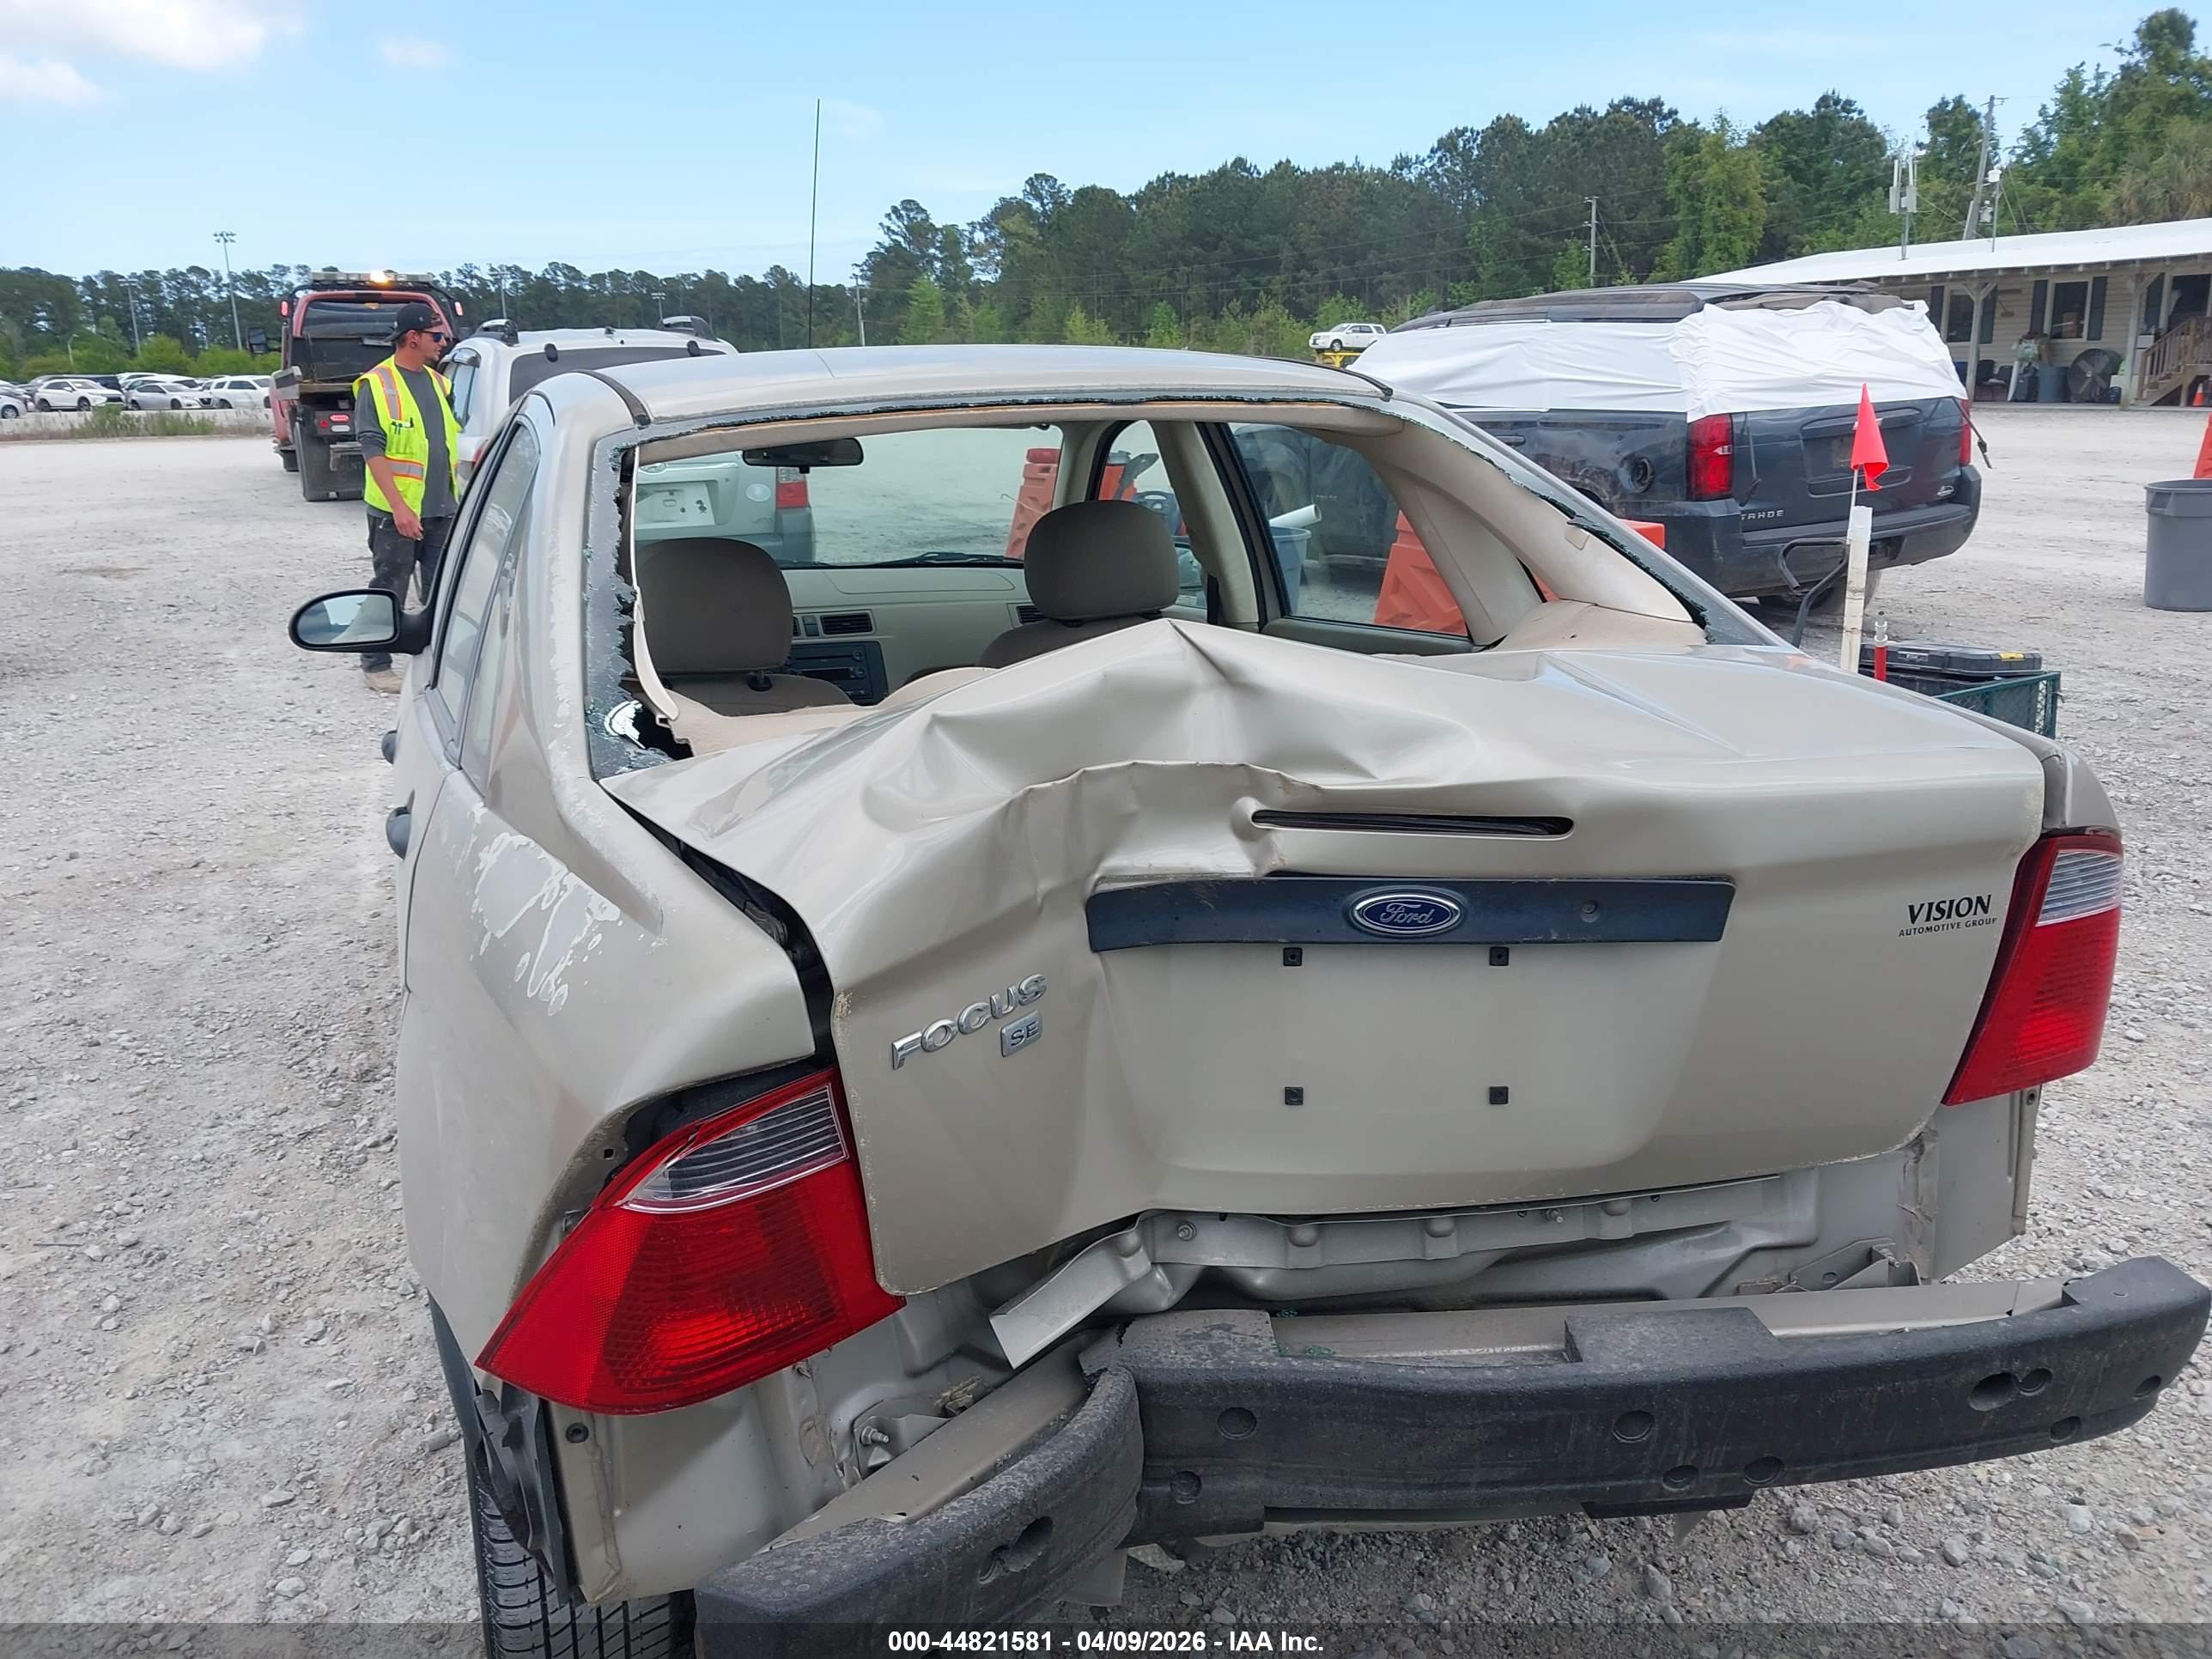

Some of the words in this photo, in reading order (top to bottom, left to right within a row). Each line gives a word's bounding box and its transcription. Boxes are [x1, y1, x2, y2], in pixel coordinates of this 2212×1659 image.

[1379, 902, 1436, 924] Ford
[1907, 894, 1992, 925] VISION
[1898, 921, 1962, 938] AUTOMOTIVE
[1964, 917, 1997, 928] GROUP
[891, 974, 1047, 1071] FOCUS
[1010, 1021, 1039, 1047] SE
